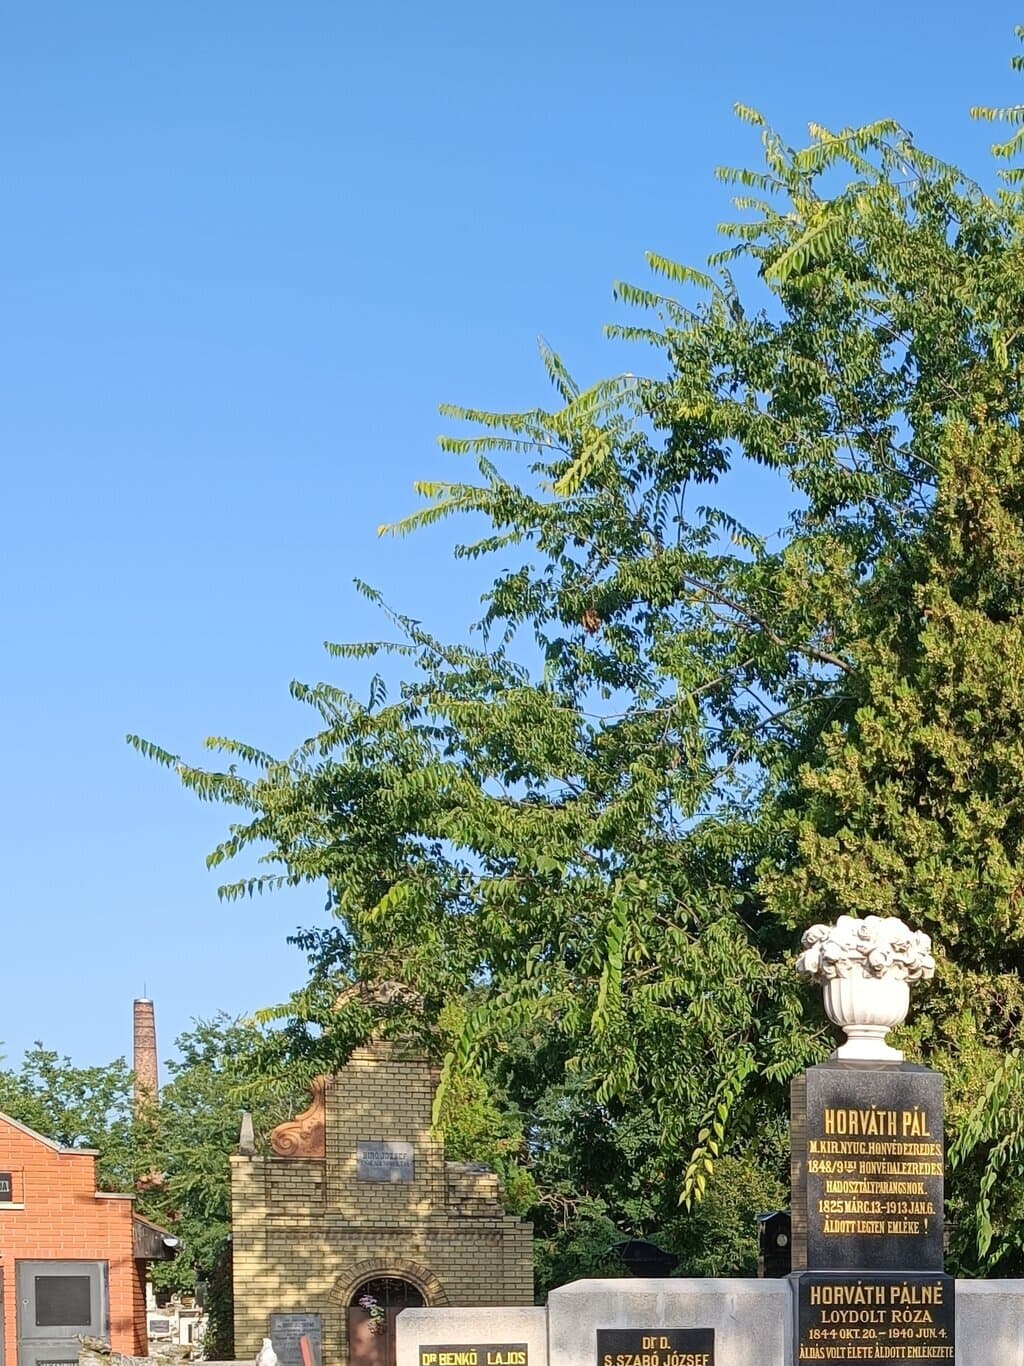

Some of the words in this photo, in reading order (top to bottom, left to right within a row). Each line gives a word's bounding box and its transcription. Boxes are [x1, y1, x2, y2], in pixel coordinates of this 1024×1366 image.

[825, 1104, 896, 1135] HORVÁTH
[903, 1104, 930, 1136] PÁL
[824, 1215, 856, 1233] ÁLDOTT
[857, 1221, 885, 1234] LEGYEN
[887, 1217, 919, 1234] EMLÉKE
[811, 1281, 885, 1305] HORVÁTH
[890, 1281, 943, 1305] PÁLNÉ
[821, 1310, 886, 1323] LOYDOLT
[892, 1306, 932, 1323] RÓZA
[809, 1329, 837, 1339] 1844
[487, 1352, 526, 1365] LAJOS
[800, 1344, 825, 1359] ÁLDÁS
[826, 1347, 846, 1359] VOLT
[848, 1343, 873, 1359] ÉLETE
[875, 1342, 906, 1359] ÁLDOTT
[907, 1343, 954, 1358] EMLÉKEZETE
